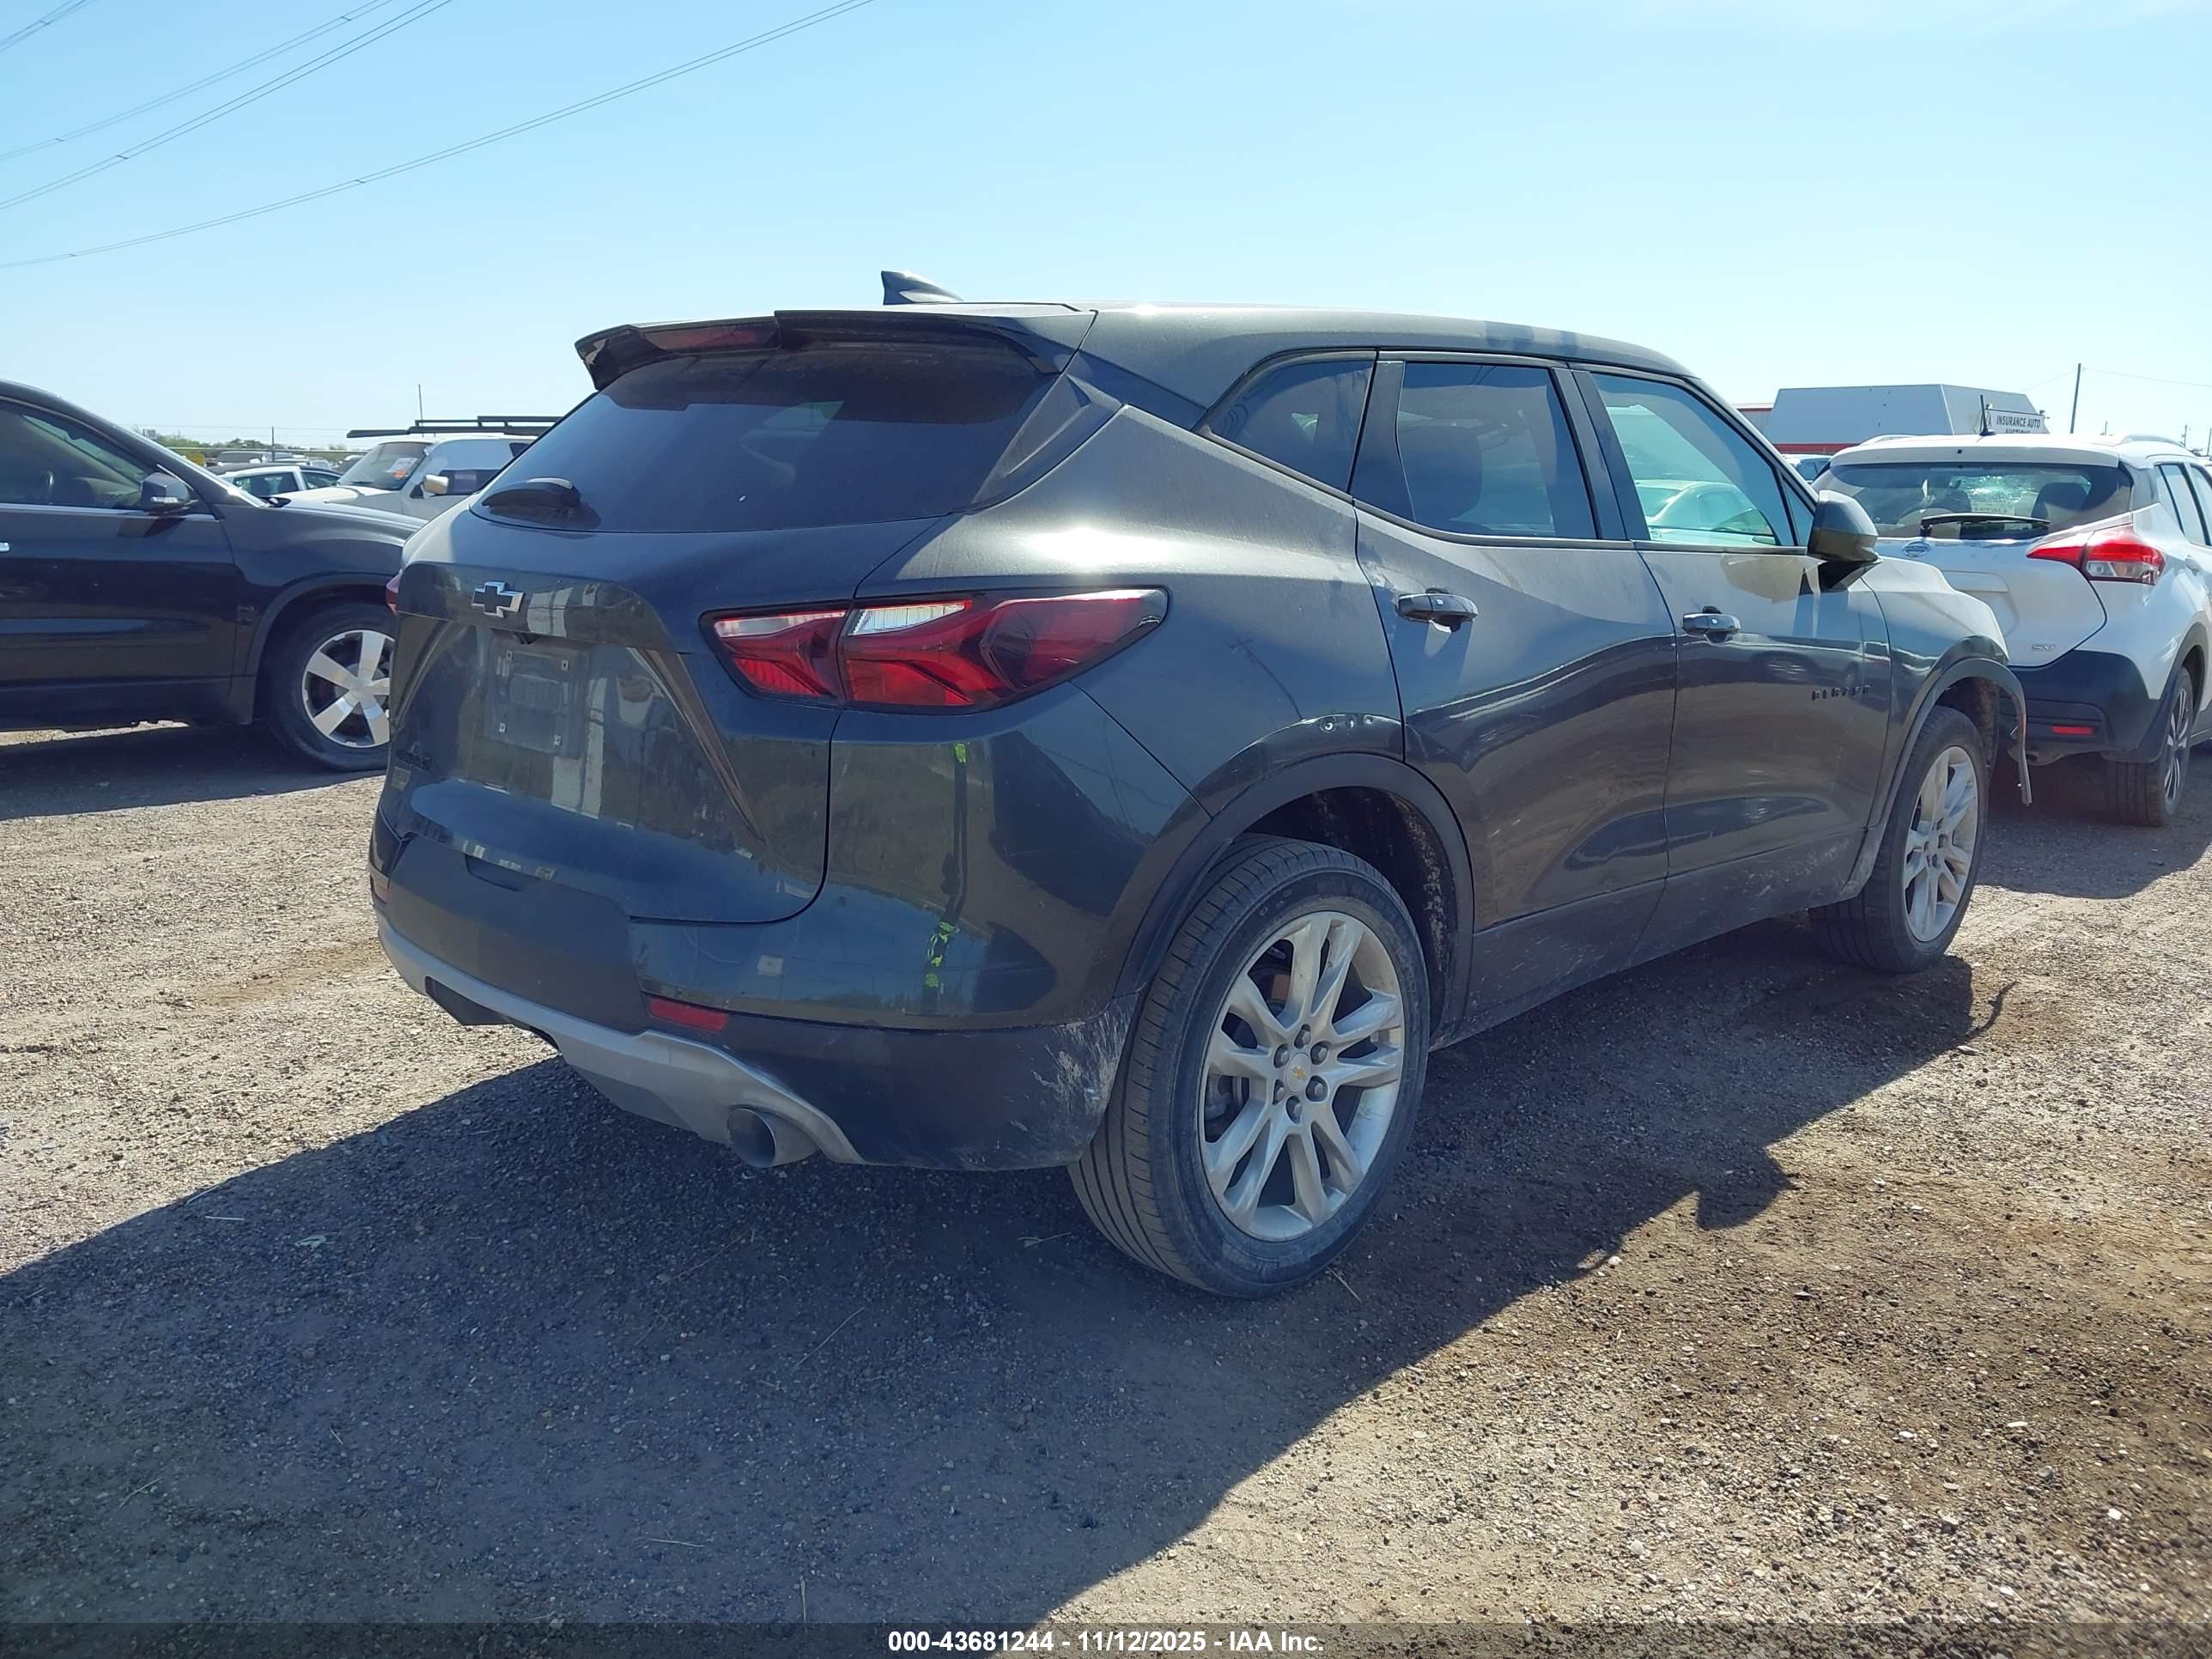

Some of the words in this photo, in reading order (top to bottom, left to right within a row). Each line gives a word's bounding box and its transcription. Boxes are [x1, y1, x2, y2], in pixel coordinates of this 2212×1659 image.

[1996, 416, 2027, 427] INSURANCE
[2027, 418, 2041, 428] AUTO
[2032, 644, 2056, 653] SV
